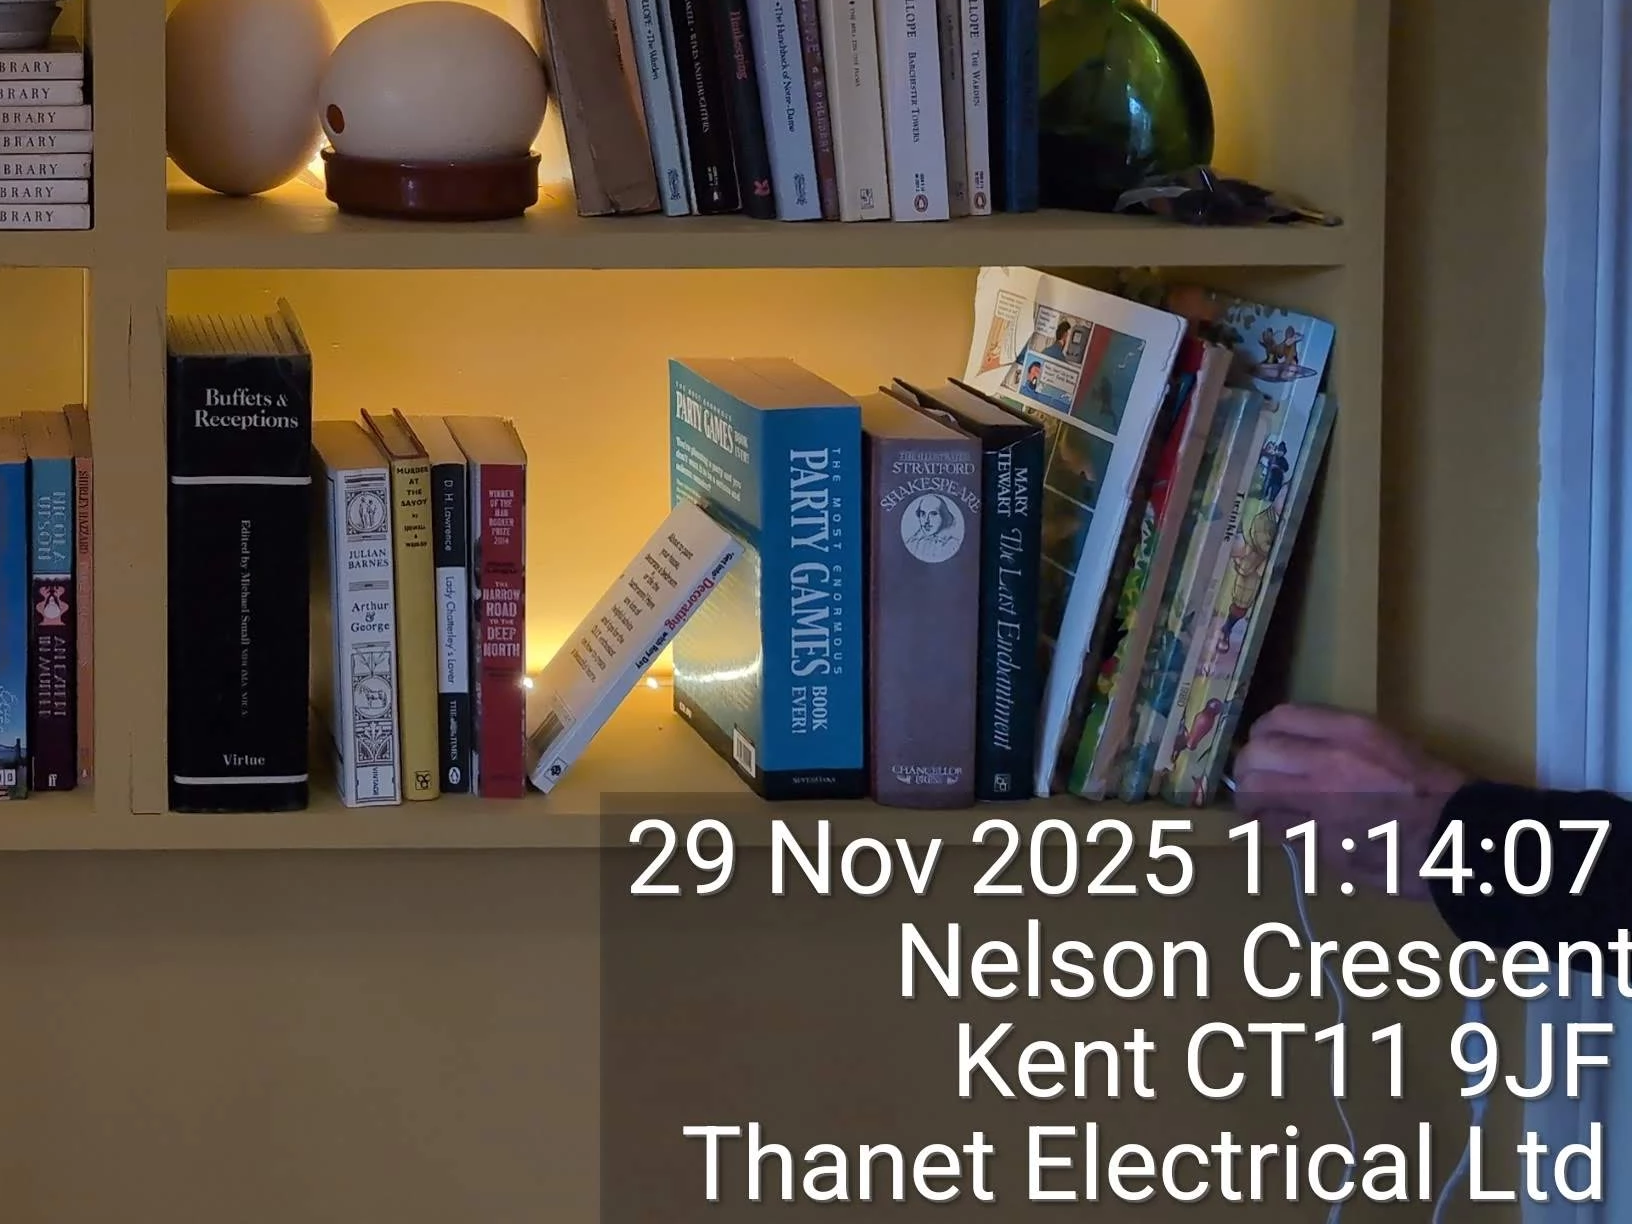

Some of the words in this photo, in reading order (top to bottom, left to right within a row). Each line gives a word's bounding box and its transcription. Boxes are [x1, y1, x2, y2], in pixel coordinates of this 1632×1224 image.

[774, 7, 784, 23] The
[777, 24, 790, 70] Hunchback
[204, 387, 272, 408] Buffets
[276, 393, 289, 408] &
[193, 409, 299, 431] Receptions
[676, 390, 702, 433] PARTY
[703, 408, 734, 455] GAMES
[396, 466, 429, 474] MURDER
[832, 448, 841, 482] THE
[892, 461, 976, 475] STRATFORD
[401, 498, 427, 507] SAVOY
[790, 447, 829, 552] PARTY
[880, 477, 983, 514] SHAKESPEARE
[1014, 467, 1029, 517] MARY
[444, 506, 454, 552] Lawrence
[832, 497, 841, 550] MOST
[1224, 491, 1245, 543] Twinkle
[240, 519, 252, 554] Edited
[999, 526, 1023, 563] The
[239, 556, 251, 569] by
[348, 559, 389, 570] BARNES
[349, 548, 386, 559] JULIAN
[240, 572, 251, 613] Michael
[444, 575, 455, 599] Lady
[483, 589, 520, 601] NARROW
[998, 567, 1022, 616] Last
[351, 600, 389, 612] Arthur
[365, 611, 375, 622] &
[486, 602, 517, 617] ROAD
[664, 577, 715, 631] Decorating
[790, 561, 831, 677] GAMES
[240, 615, 251, 645] Small
[350, 622, 390, 633] George
[487, 627, 516, 641] DEEP
[833, 565, 842, 675] ENORMOUS
[483, 643, 520, 657] NORTH
[447, 660, 457, 684] Lover
[993, 619, 1021, 751] Enchantment
[791, 686, 807, 734] EVER!
[811, 685, 828, 730] BOOK
[222, 753, 266, 767] Virtue
